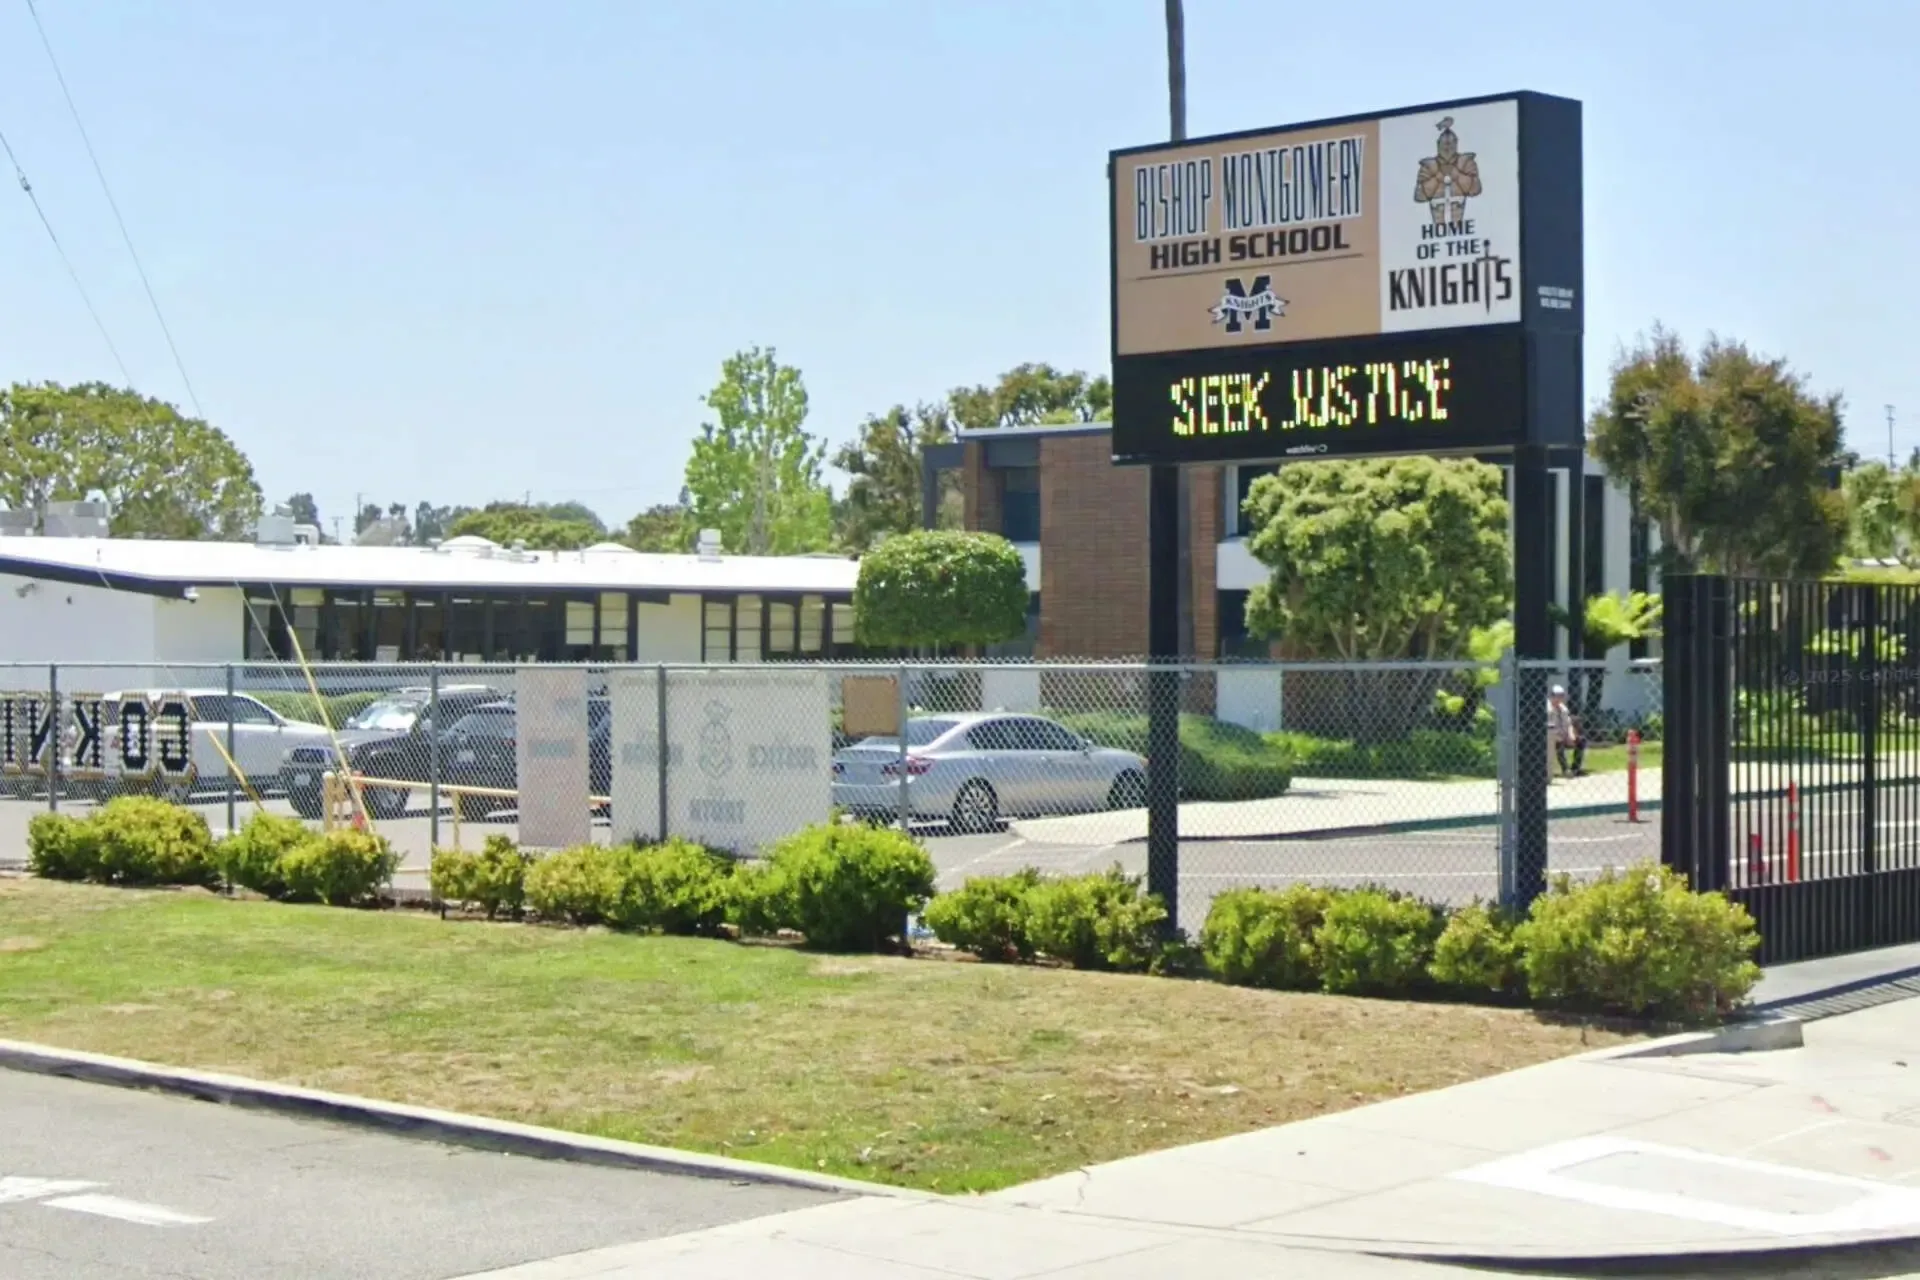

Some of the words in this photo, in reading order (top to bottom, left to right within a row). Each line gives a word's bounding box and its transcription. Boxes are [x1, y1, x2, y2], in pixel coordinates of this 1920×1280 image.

[1136, 158, 1212, 241] BISHOP
[1222, 137, 1364, 230] MONTGOMERY
[1150, 238, 1221, 270] HIGH
[1229, 224, 1350, 261] SCHOOL
[1417, 243, 1441, 260] OF
[1445, 239, 1480, 256] THE
[1421, 219, 1475, 240] HOME
[1225, 293, 1273, 309] KNIGHTS
[1225, 275, 1270, 333] M
[1388, 254, 1512, 315] KNIGHTS
[1171, 371, 1270, 435] SEEK
[1281, 358, 1449, 428] JUSTICE
